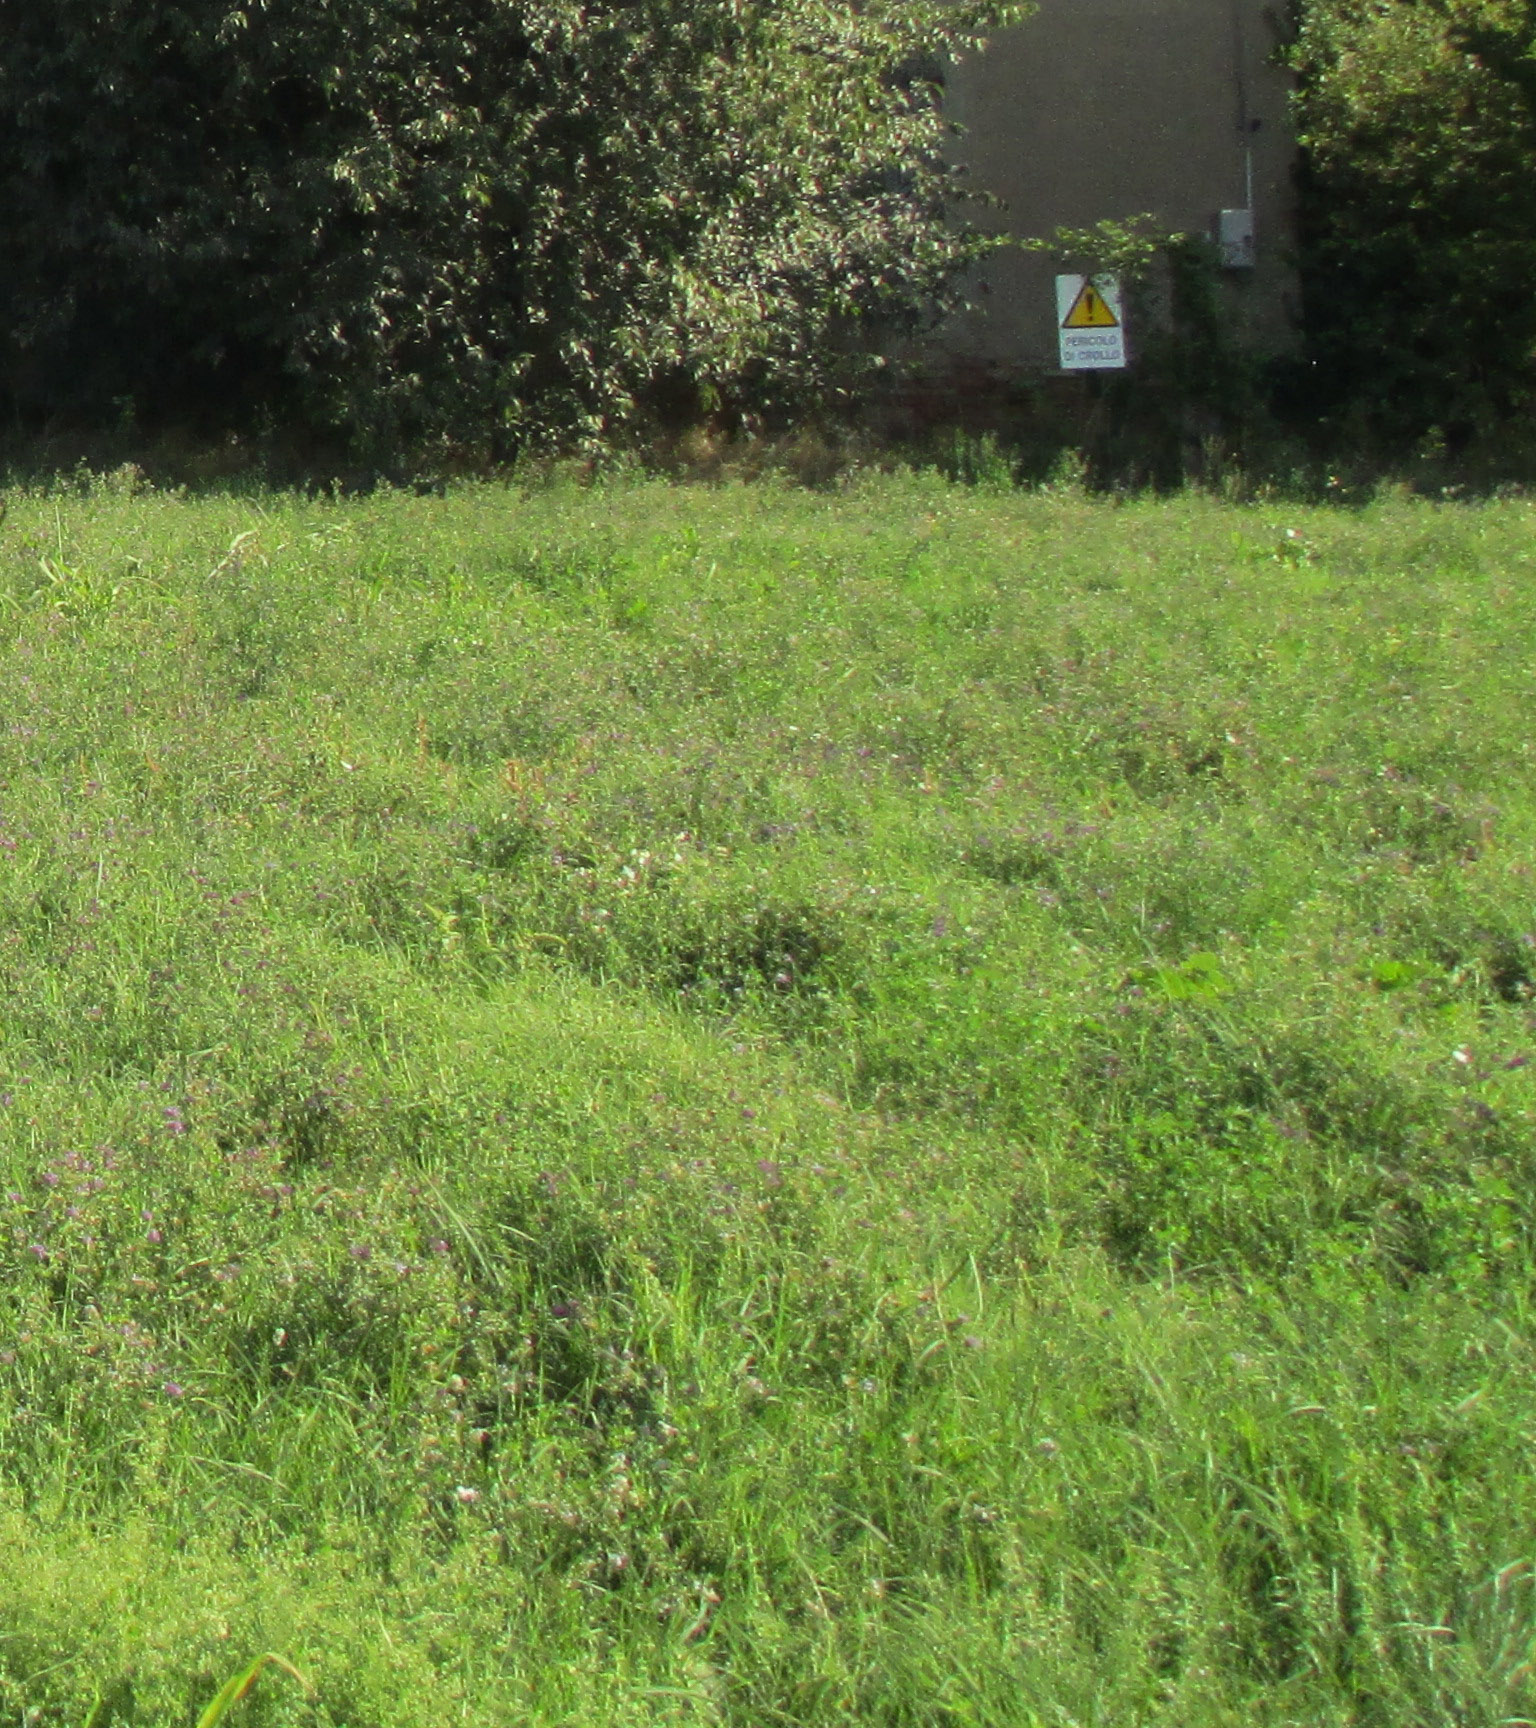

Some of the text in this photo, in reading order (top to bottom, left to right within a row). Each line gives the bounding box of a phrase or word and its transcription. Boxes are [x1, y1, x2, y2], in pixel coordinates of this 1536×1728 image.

[1065, 336, 1117, 346] PERICOLO
[1064, 350, 1121, 361] DI CROLLO
